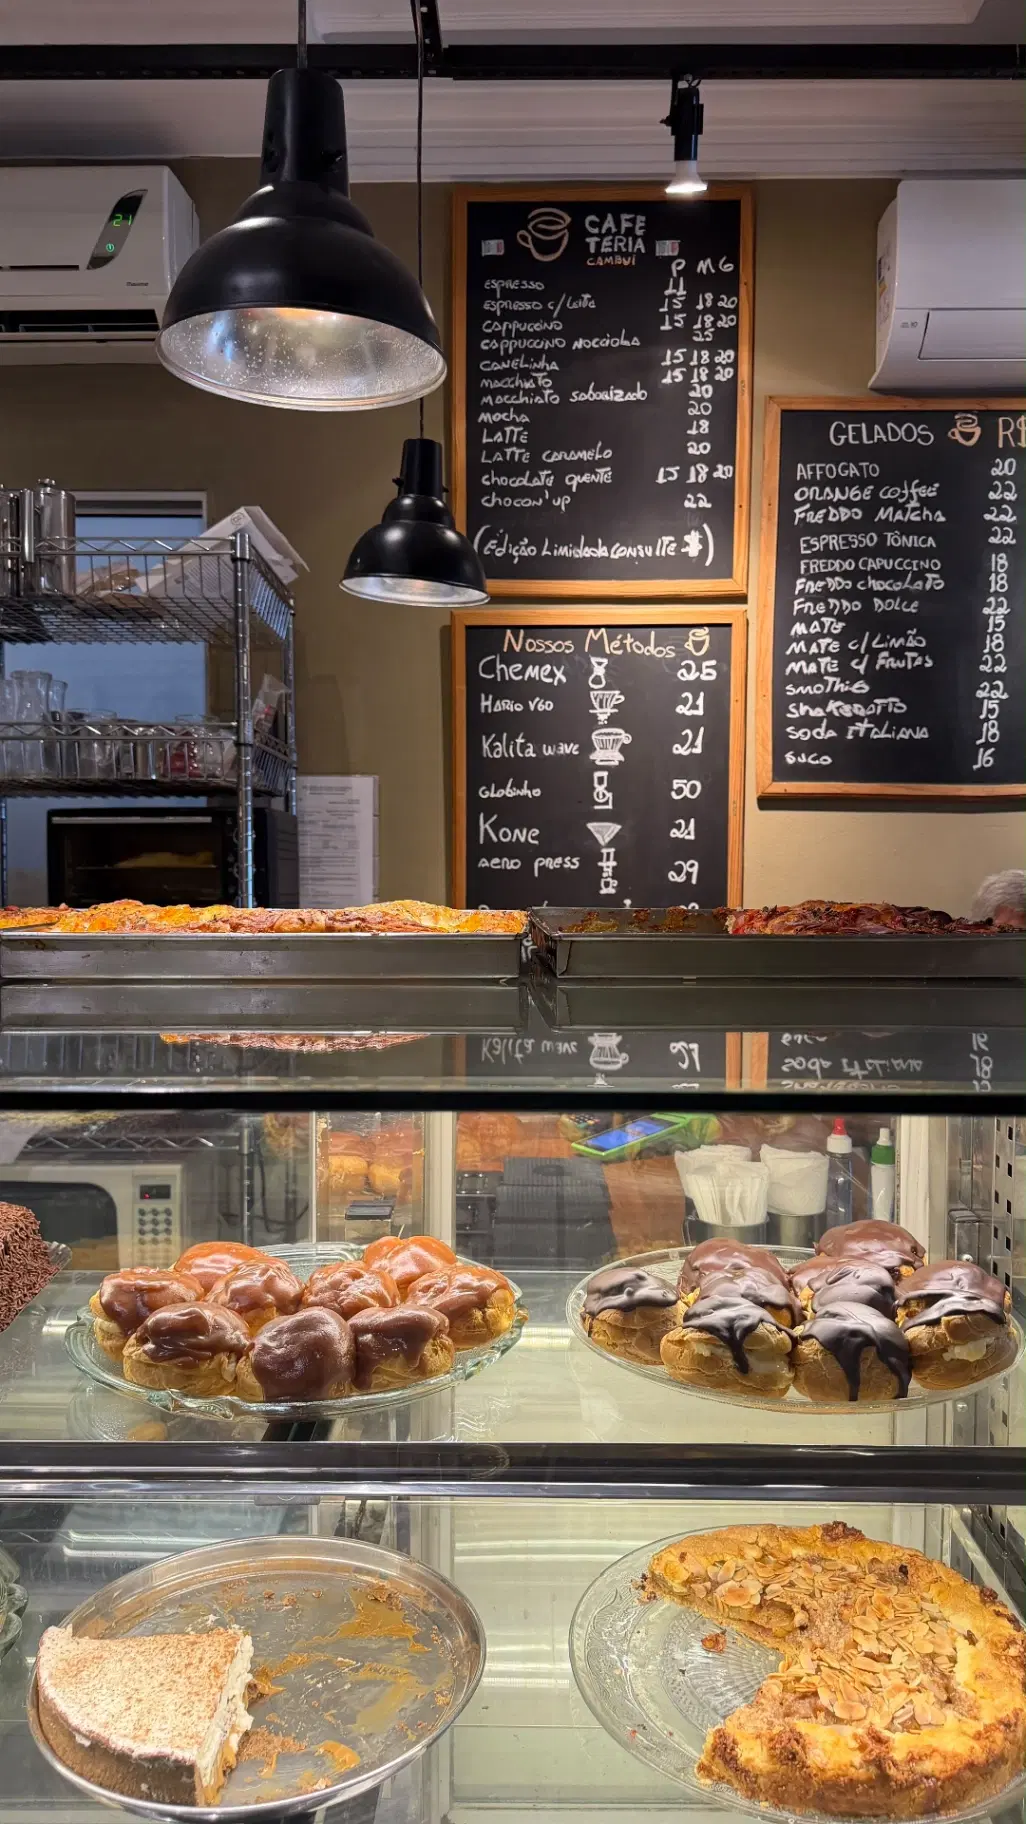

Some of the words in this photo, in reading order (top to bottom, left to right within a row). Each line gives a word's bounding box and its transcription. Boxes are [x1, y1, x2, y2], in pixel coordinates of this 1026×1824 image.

[113, 214, 132, 227] 21
[585, 213, 646, 235] CAFE
[585, 236, 646, 254] TERIA
[671, 259, 686, 277] P
[696, 258, 716, 274] M
[718, 256, 734, 272] G
[484, 280, 544, 299] ESPRESSO
[664, 276, 686, 296] 11
[483, 300, 543, 317] ESPRESSO
[659, 296, 686, 312] 15
[696, 292, 714, 310] 18
[717, 294, 738, 308] 20
[660, 314, 686, 330] 15
[692, 314, 714, 330] 18
[716, 314, 737, 328] 20
[692, 328, 715, 342] 25
[660, 348, 687, 366] 15
[688, 349, 710, 366] 18
[714, 349, 735, 365] 20
[661, 368, 687, 384] 15
[690, 366, 709, 383] 18
[714, 366, 734, 382] 20
[688, 383, 713, 399] 20
[688, 400, 712, 416] 20
[482, 426, 528, 444] LATTE
[687, 420, 710, 436] 18
[829, 420, 935, 446] GELADOS
[481, 446, 531, 464] LATTE
[687, 442, 712, 456] 20
[656, 466, 680, 484] 15
[686, 464, 710, 484] 18
[713, 464, 733, 480] 20
[796, 462, 880, 481] AFFOGATO
[990, 458, 1016, 476] 20
[684, 493, 712, 509] 22
[794, 486, 874, 502] ORANGE
[988, 480, 1017, 502] 22
[983, 504, 1017, 524] 22
[800, 532, 878, 554] ESPRESSO
[883, 530, 937, 548] TÔNICA
[988, 526, 1016, 544] 22
[800, 558, 855, 575] FREDDO
[858, 557, 942, 572] CAPUCCINO
[990, 553, 1008, 572] 18
[988, 572, 1008, 593] 18
[982, 596, 1011, 616] 22
[986, 615, 1006, 633] 15
[503, 630, 575, 654] Nossos
[584, 628, 676, 658] Métodos
[786, 638, 840, 656] MATE
[983, 634, 1004, 653] 18
[478, 654, 568, 686] Chemex
[676, 659, 718, 682] 25
[786, 656, 840, 676] MATE
[979, 654, 1008, 673] 22
[976, 680, 1009, 700] 22
[675, 691, 705, 716] 21
[980, 699, 1000, 720] 15
[482, 731, 537, 759] Kalita
[542, 743, 580, 756] wave
[672, 726, 704, 756] 21
[976, 721, 1000, 746] 18
[972, 748, 996, 771] 16
[670, 778, 702, 800] 50
[479, 812, 540, 845] Kone
[670, 818, 696, 841] 21
[668, 860, 699, 884] 29
